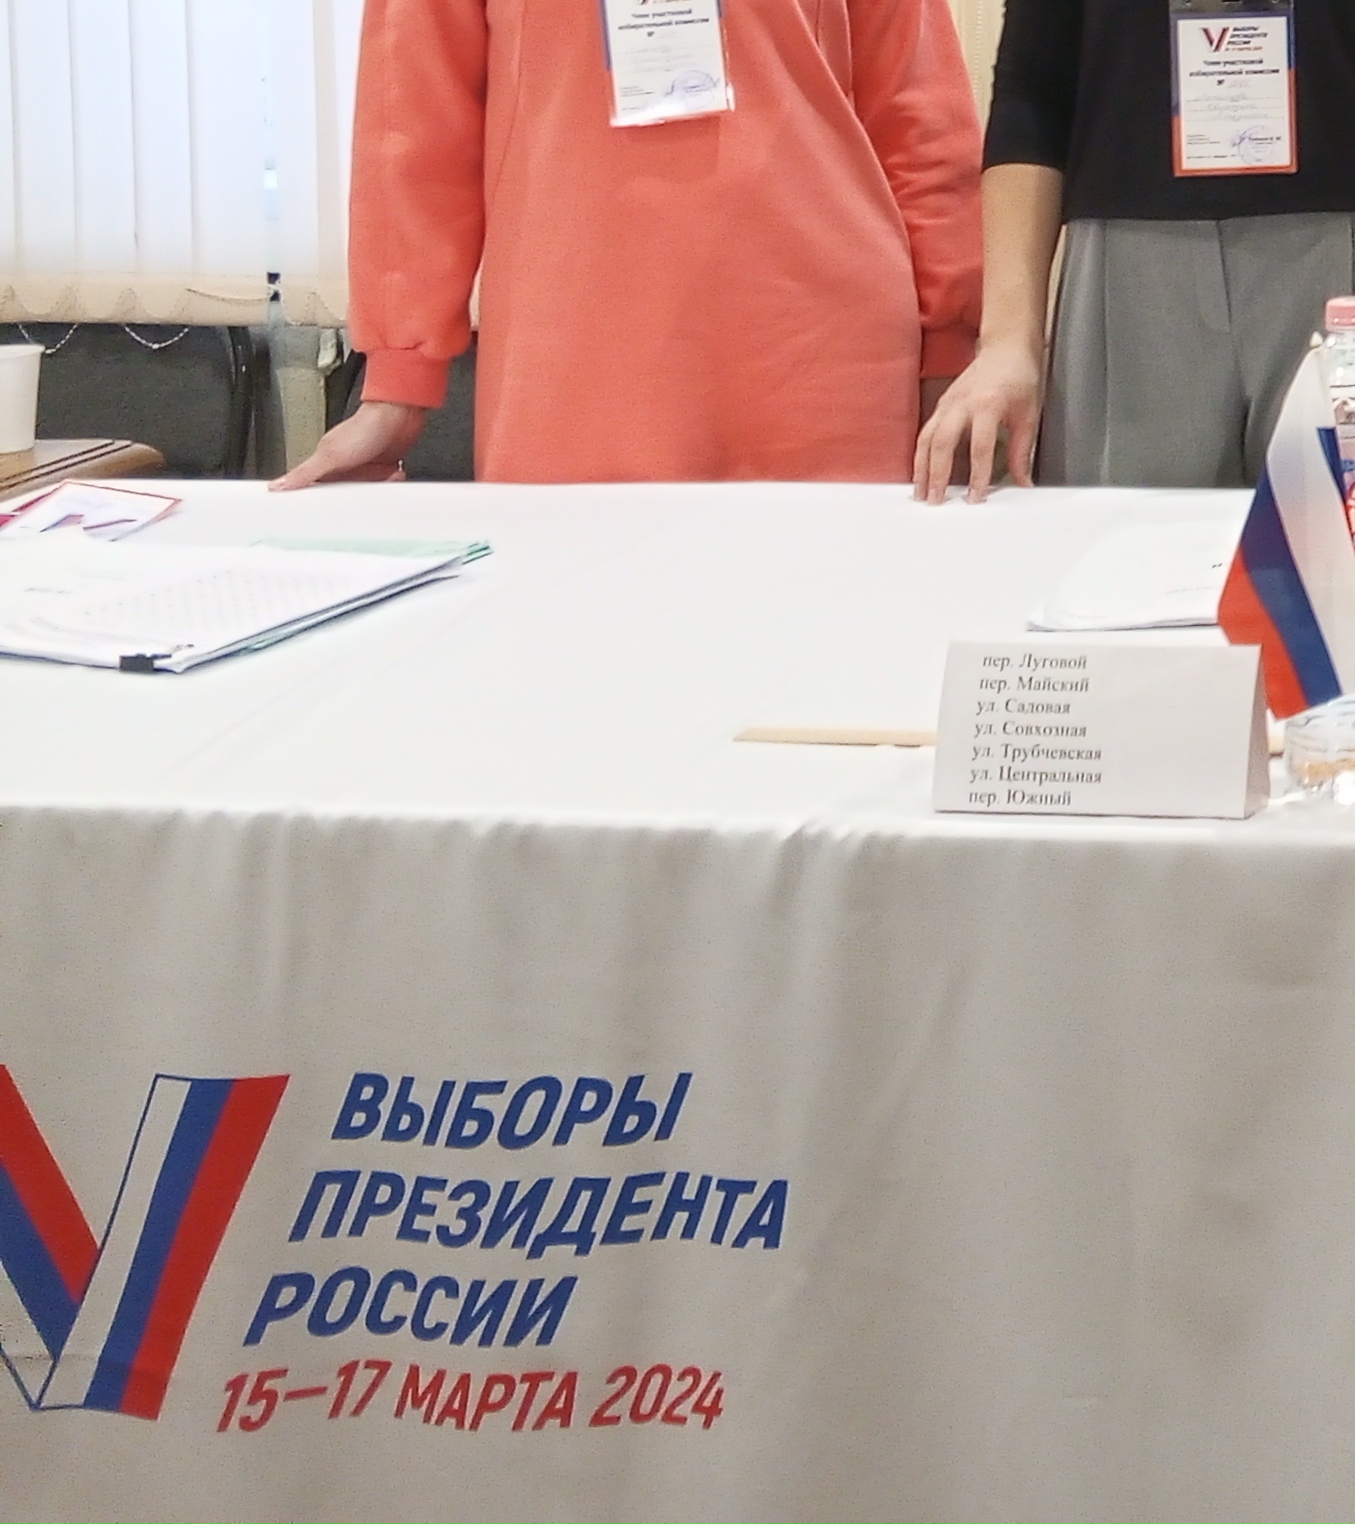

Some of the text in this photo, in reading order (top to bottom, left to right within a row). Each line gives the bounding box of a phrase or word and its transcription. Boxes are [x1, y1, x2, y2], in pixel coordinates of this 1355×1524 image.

[982, 653, 1088, 672] пер. Луговой
[979, 676, 1090, 694] пер. Майский
[976, 698, 1071, 715] ул. Садовая
[974, 721, 1088, 738] ул. Совхозная
[972, 743, 1102, 762] ул. Трубчевская
[970, 766, 1102, 784] ул. Центральная
[968, 788, 1072, 806] пер. Южный
[332, 1072, 693, 1150] ВЫБОРЫ
[289, 1169, 789, 1259] ПРЕЗИДЕНТА
[243, 1267, 578, 1347] РОССИИ
[395, 1363, 580, 1433] МАРТА
[589, 1363, 725, 1429] 2024
